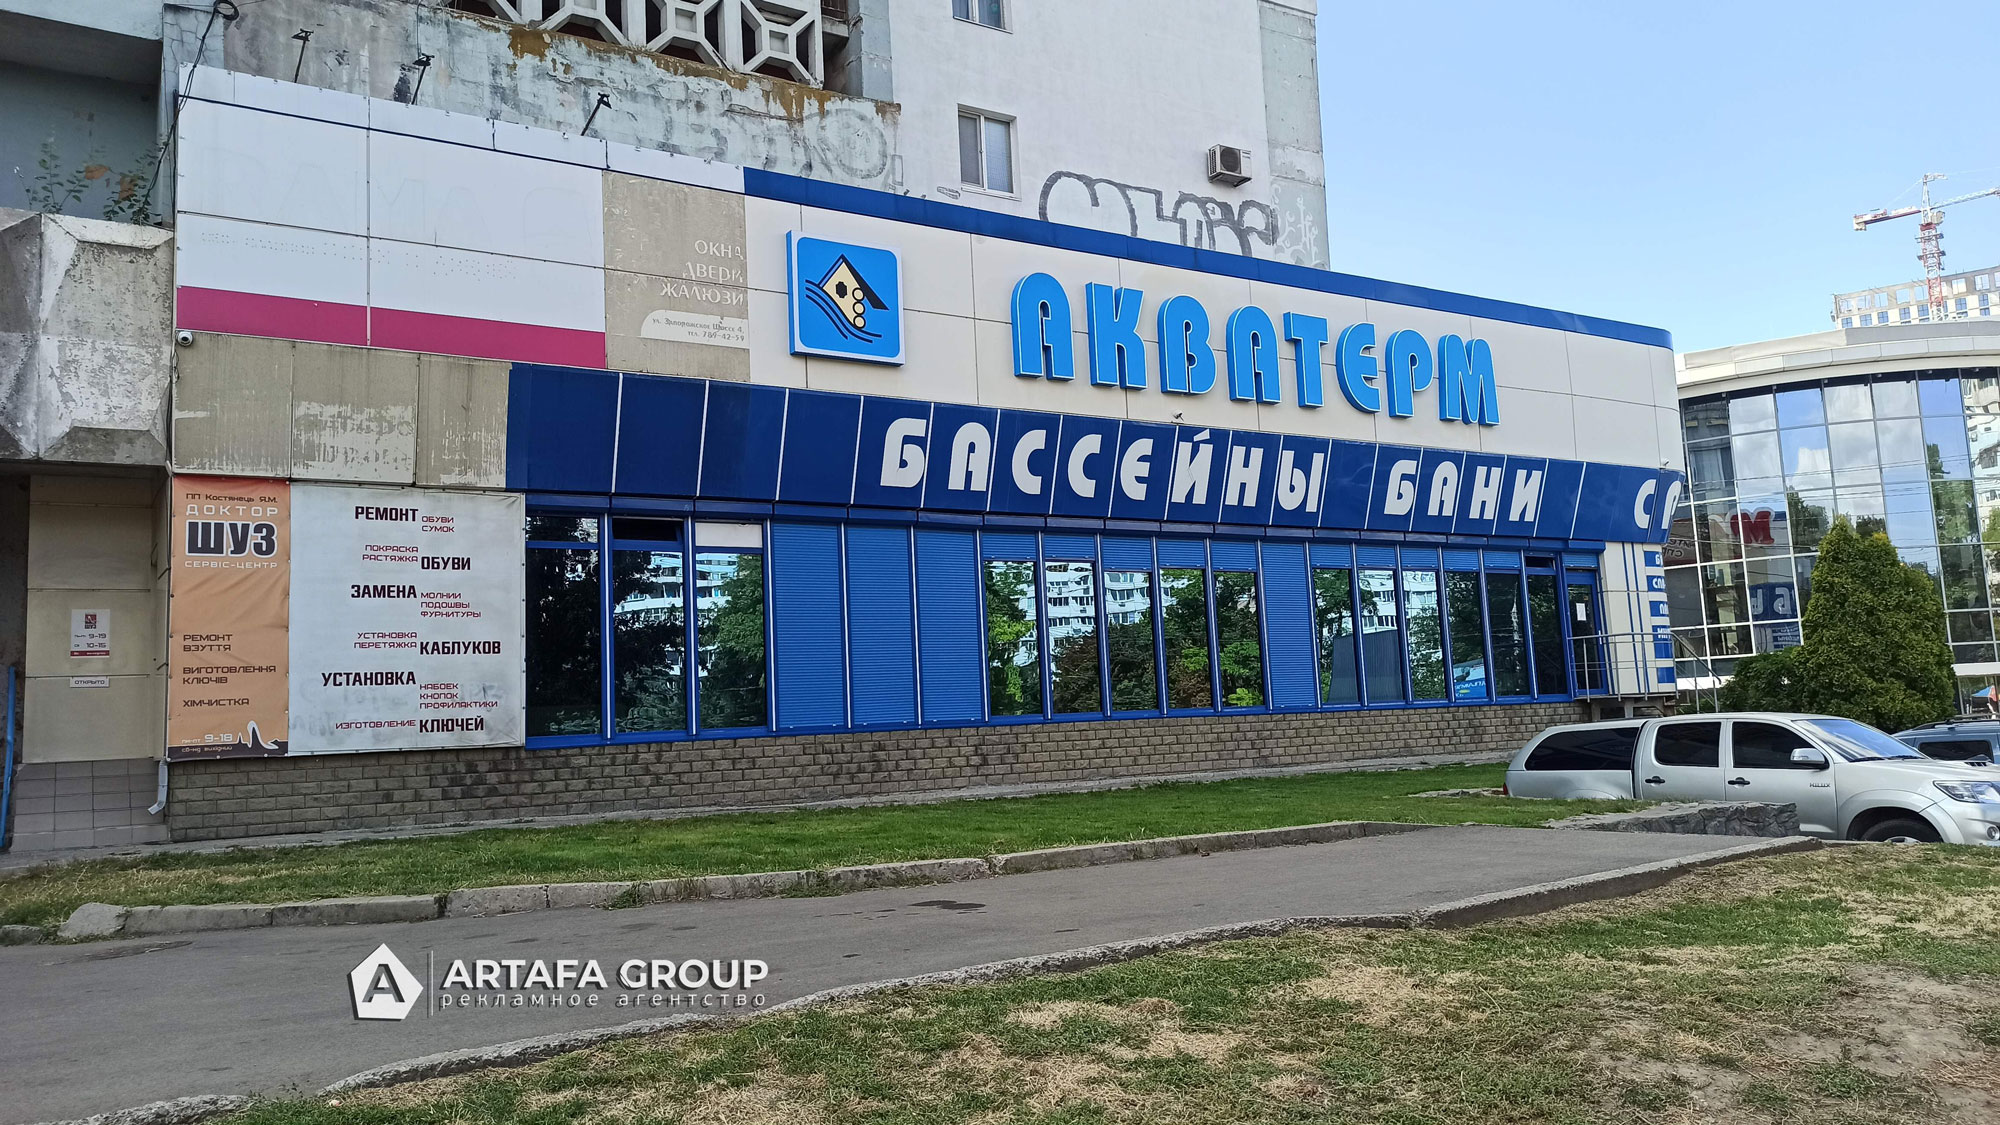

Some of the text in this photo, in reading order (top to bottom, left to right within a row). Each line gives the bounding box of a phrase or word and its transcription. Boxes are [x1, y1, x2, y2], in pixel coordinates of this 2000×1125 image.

[660, 283, 744, 305] ЖАЛЮЗИ
[1011, 272, 1500, 426] АКВАТЕРМ
[880, 417, 1325, 513] БАССЕЙНЫ
[1383, 459, 1544, 522] БАНИ
[205, 493, 255, 503] Костянець
[186, 504, 278, 517] ДОКТОР
[355, 506, 419, 522] РЕМОНТ
[421, 525, 455, 533] СУМОК
[186, 520, 278, 558] ШУЗ
[365, 544, 419, 553] ПОКРАСКА
[185, 561, 278, 569] СЕРВІС-ЦЕНТР
[362, 554, 471, 571] РАСТЯЖКА ОБУВИ
[351, 584, 417, 599] ЗАМЕНА
[420, 601, 470, 610] ПОДОШВЫ
[183, 634, 233, 642] РЕМОНТ
[357, 632, 417, 640] УСТАНОВКА
[353, 641, 501, 655] ПЕРЕТЯЖКА КАБЛУКОВ
[183, 665, 276, 675] ВИГОТОВЛЕННЯ
[183, 677, 228, 685] КЛЮЧІВ
[321, 671, 416, 687] УСТАНОВКА
[420, 692, 459, 700] КНОПОК
[183, 698, 250, 707] ХІМЧИСТКА
[420, 701, 498, 710] ПРОФИЛАКТИКИ
[335, 715, 484, 733] ИЗГОТОВЛЕНИЕ КЛЮЧЕЙ
[204, 733, 233, 743] 9-18
